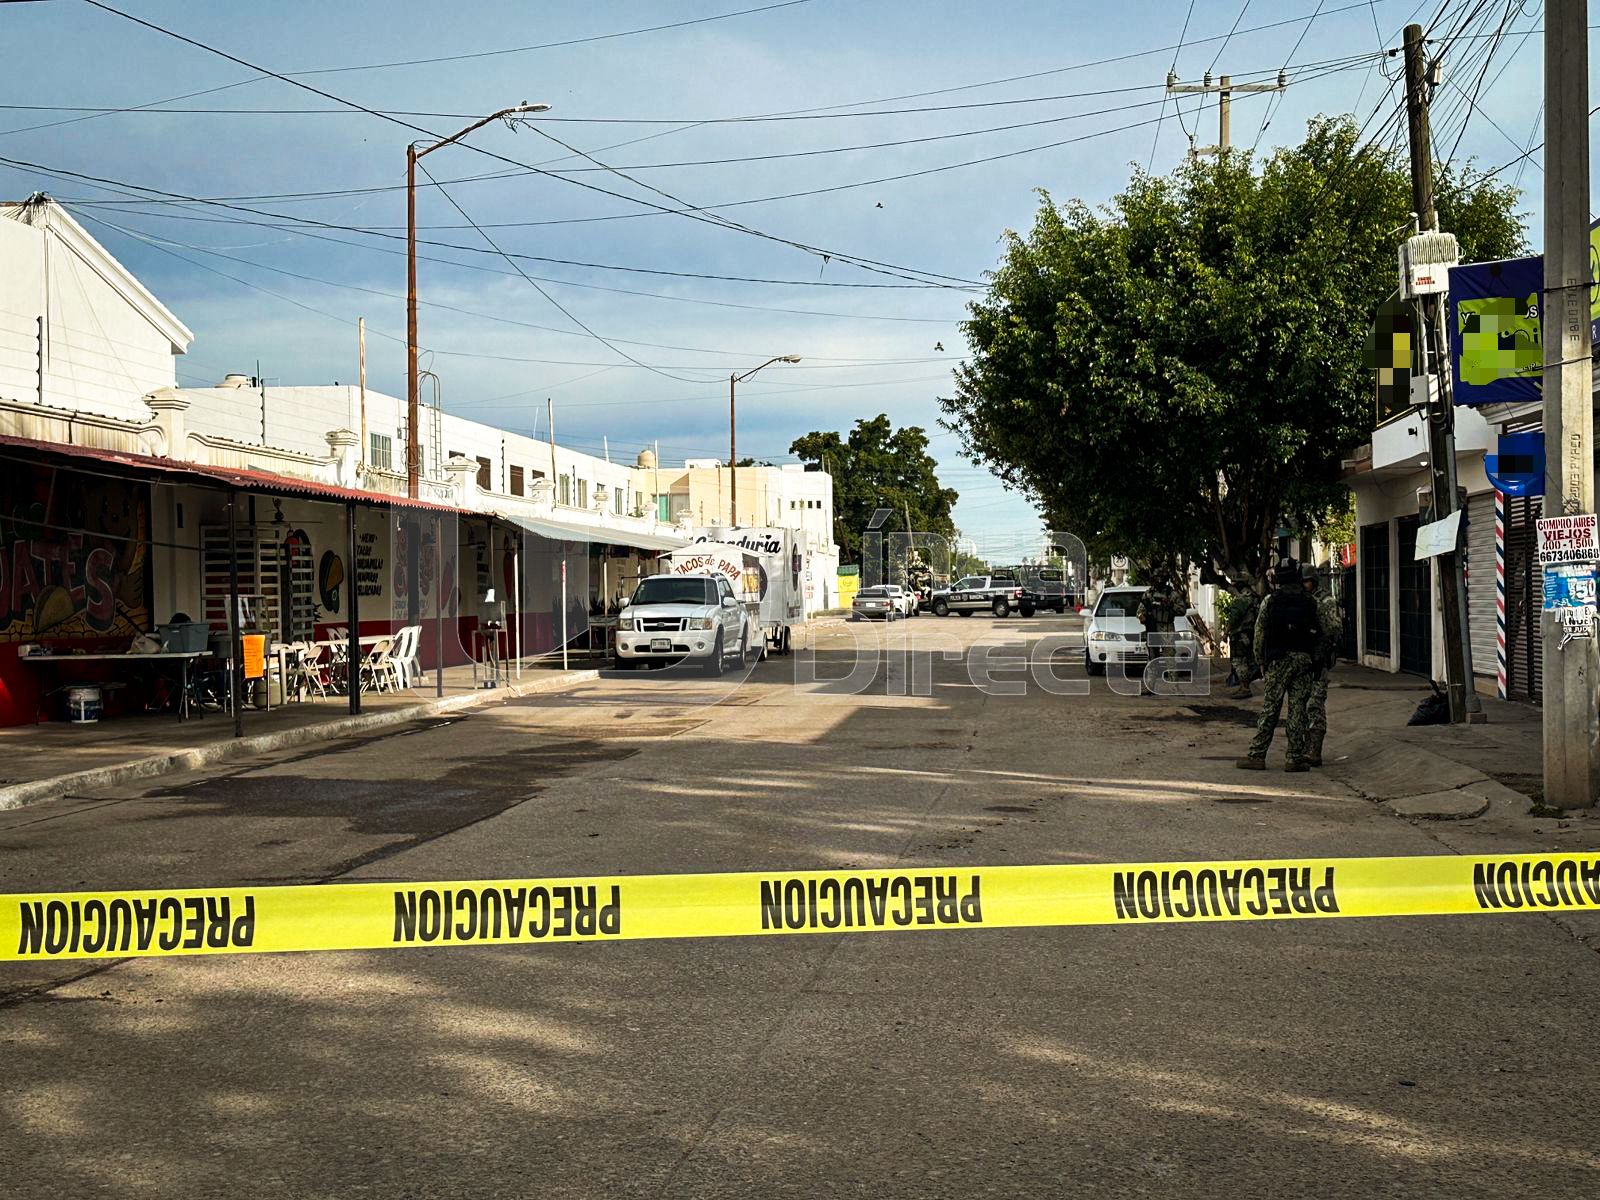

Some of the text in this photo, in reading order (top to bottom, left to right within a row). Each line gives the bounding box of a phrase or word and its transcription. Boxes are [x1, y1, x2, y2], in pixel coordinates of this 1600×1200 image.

[1537, 517, 1596, 530] COMPRO AIRES
[1543, 528, 1591, 541] VIEJOS
[674, 555, 742, 581] TACOS de PAPA
[394, 885, 621, 942] PRECAUCION
[760, 875, 983, 930] PRECAUCION
[1113, 867, 1341, 919] PRECAUCION
[18, 896, 255, 954] PRECAUCION
